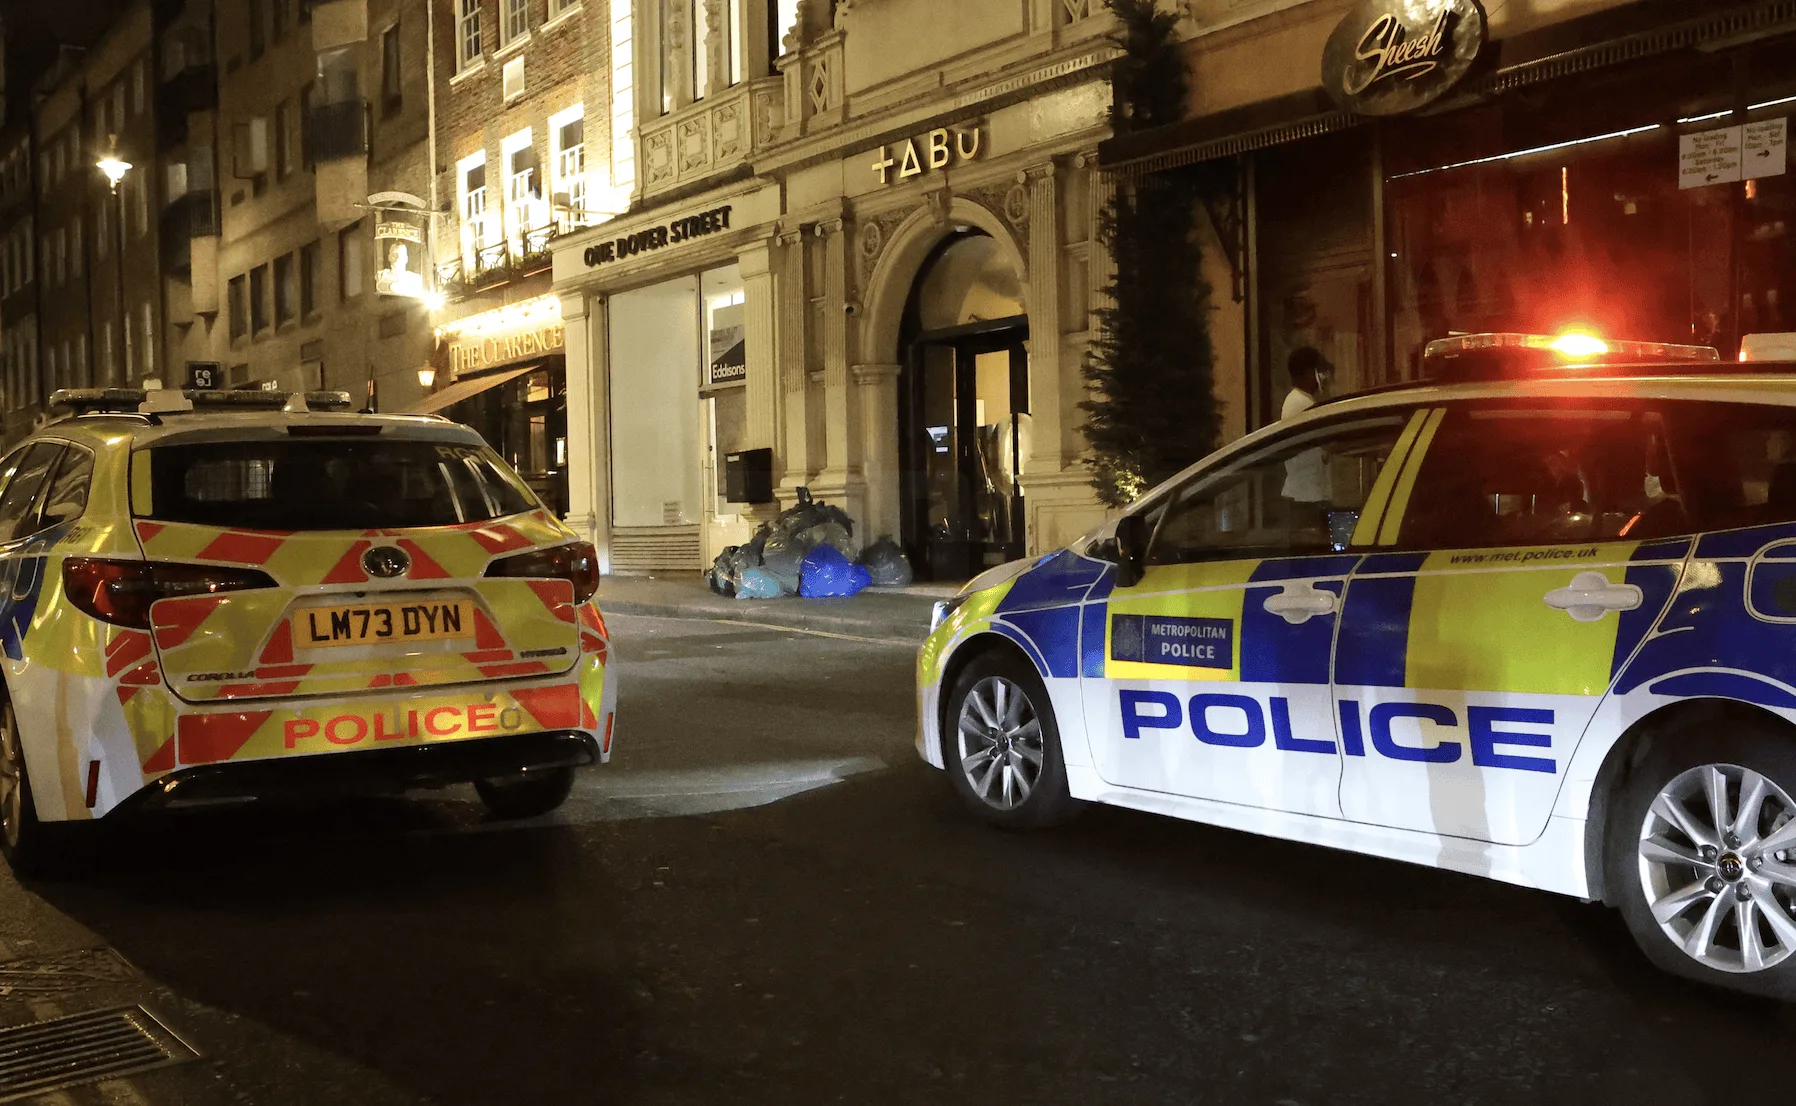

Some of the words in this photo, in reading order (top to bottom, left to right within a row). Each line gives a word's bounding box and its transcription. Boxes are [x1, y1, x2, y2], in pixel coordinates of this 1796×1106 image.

[1343, 2, 1445, 95] Sheesh
[377, 226, 419, 237] CLARENCE
[584, 241, 615, 267] ONE
[616, 225, 669, 259] DOVER
[670, 205, 732, 243] STREET
[712, 362, 745, 379] Eddisons
[1450, 546, 1599, 564] www.met.police.uk
[309, 607, 394, 642] LM73
[401, 604, 461, 636] DYN
[1151, 623, 1227, 640] METROPOLITAN
[1161, 642, 1215, 659] POLICE
[186, 670, 255, 682] COROLLA
[284, 702, 499, 749] POLICE
[1118, 689, 1557, 774] POLICE
